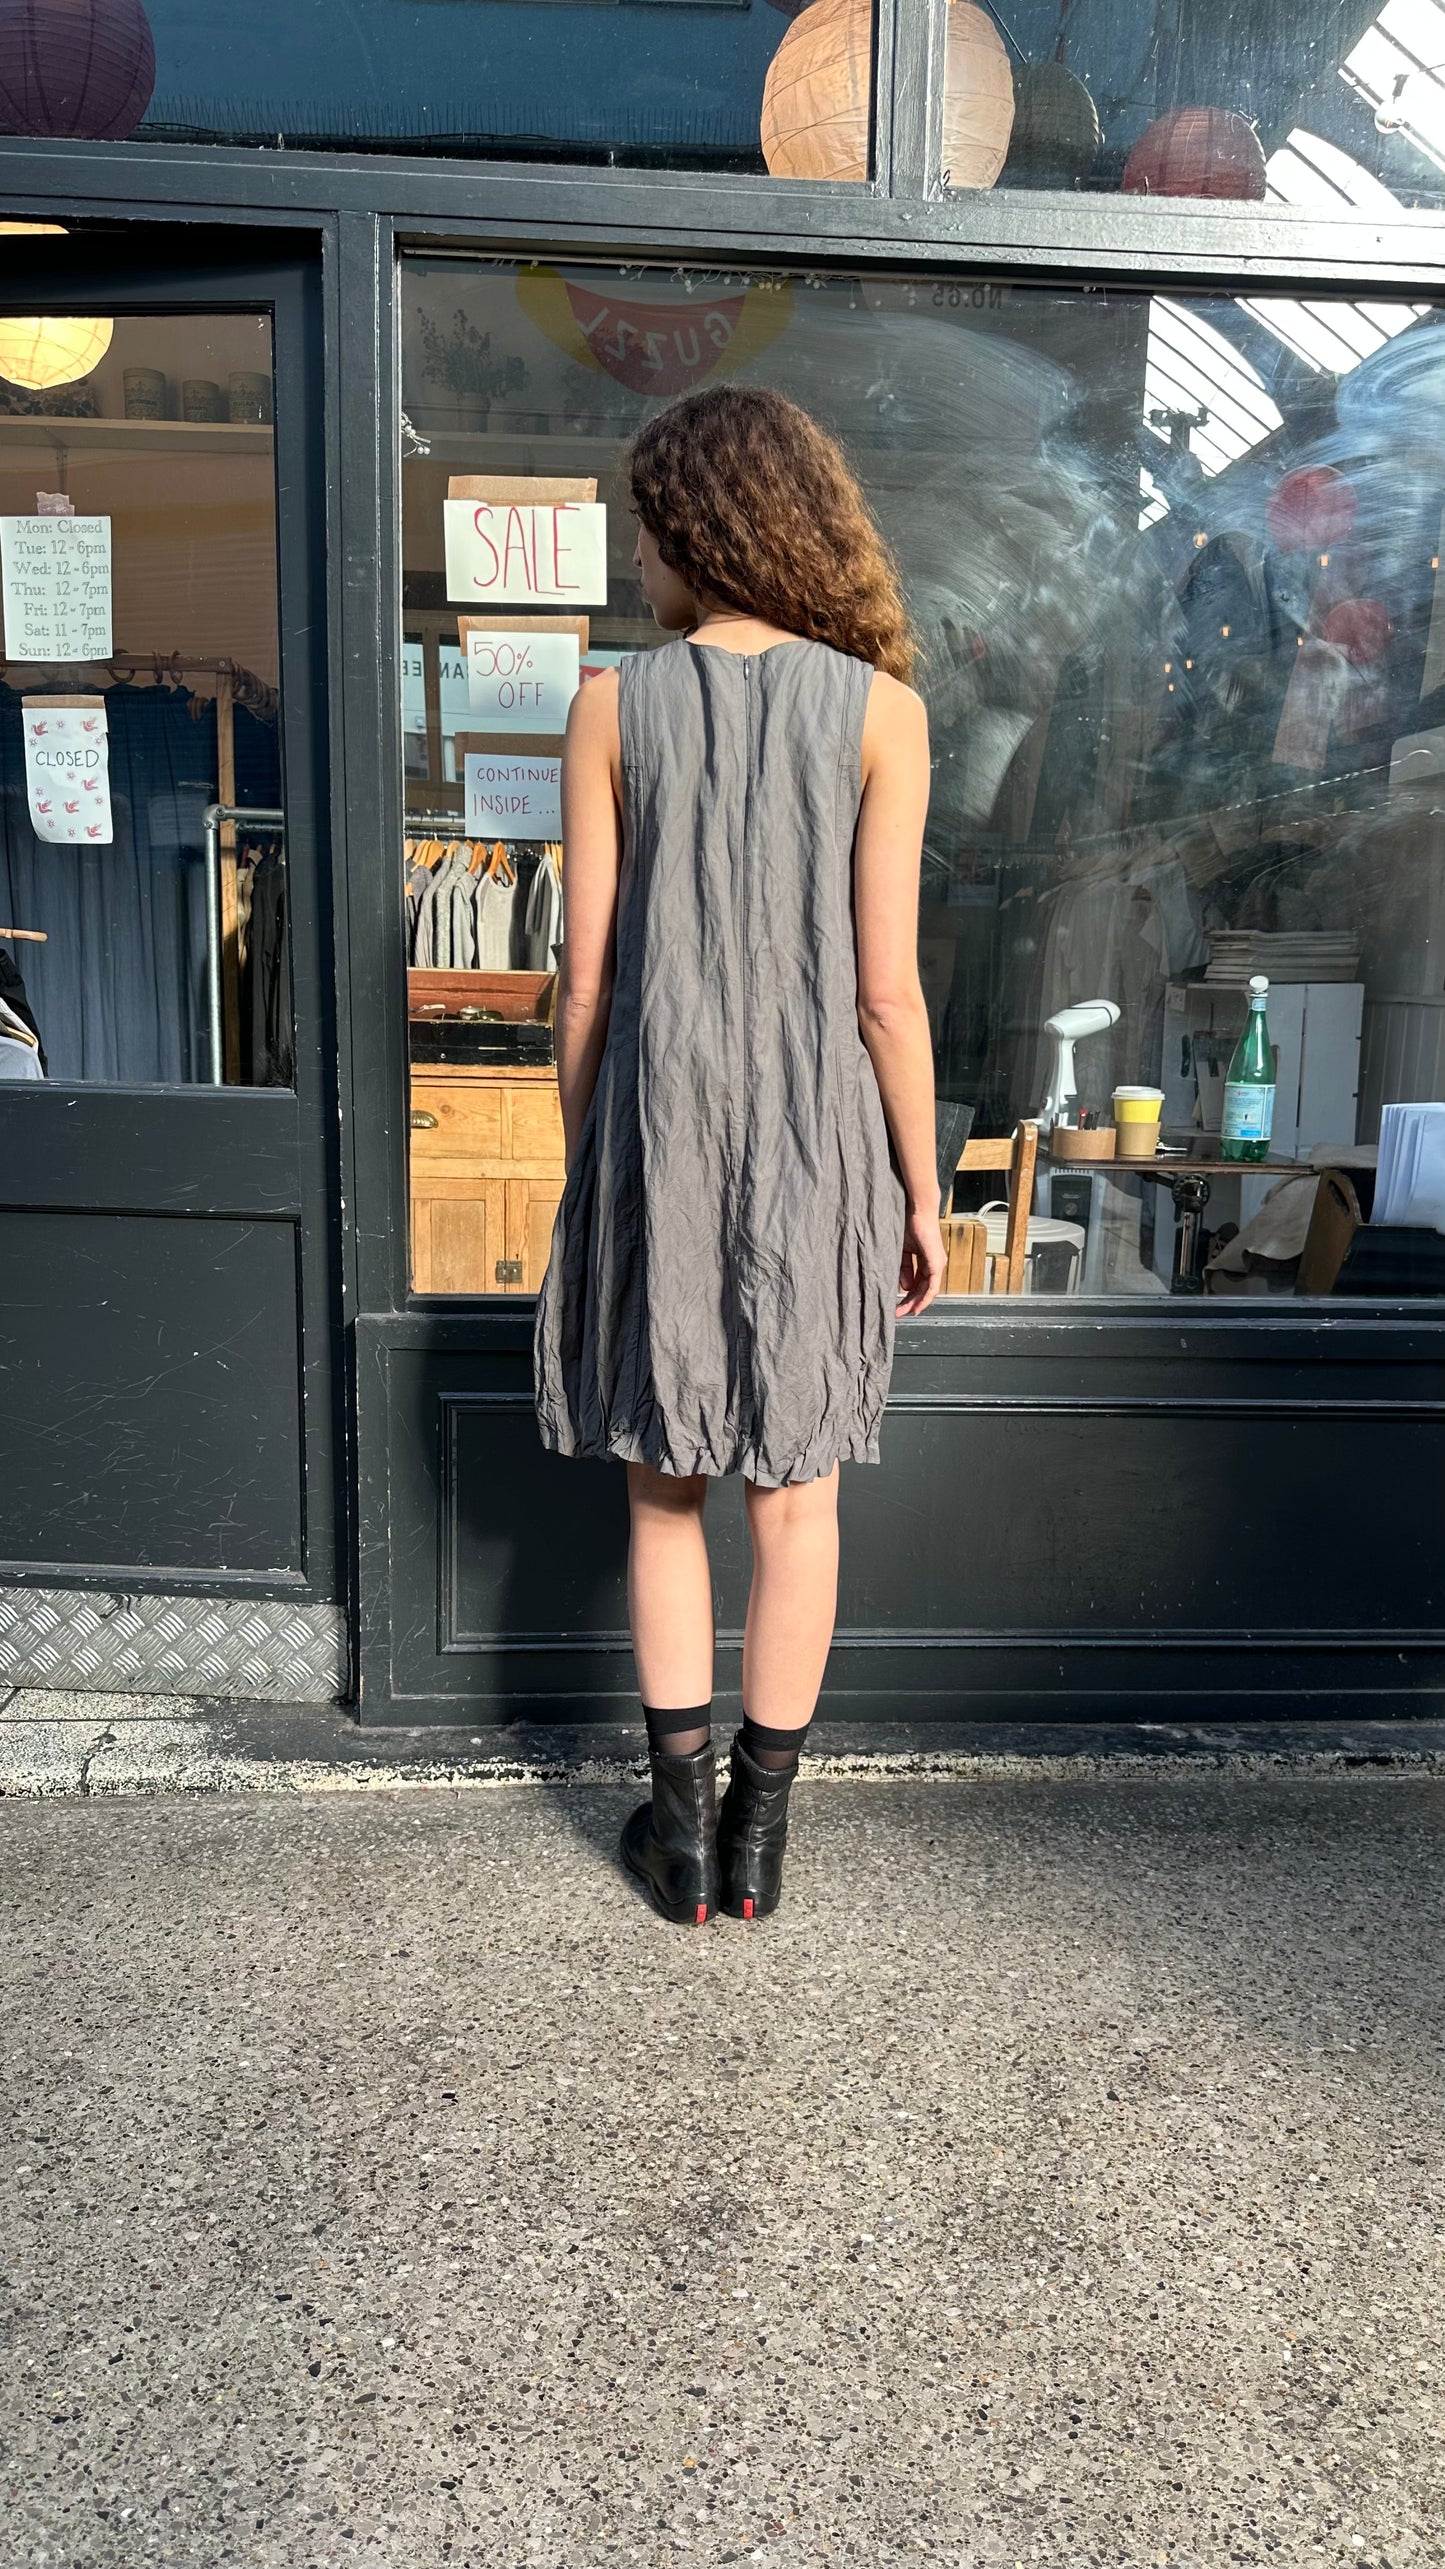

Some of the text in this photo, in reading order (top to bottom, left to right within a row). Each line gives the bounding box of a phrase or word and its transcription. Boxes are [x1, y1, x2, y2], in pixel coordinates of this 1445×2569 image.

[16, 519, 103, 534] Mon: Closed
[14, 541, 46, 554] Tue:
[473, 506, 581, 596] SALE
[13, 561, 51, 575] Wed:
[10, 582, 45, 595] Thu:
[24, 602, 47, 616] Fri:
[24, 623, 50, 636] Sat:
[19, 643, 50, 656] Sun:
[473, 641, 533, 677] 50%
[498, 681, 545, 709] OFF
[35, 749, 100, 768] CLOSED
[477, 767, 560, 784] CONTINUE
